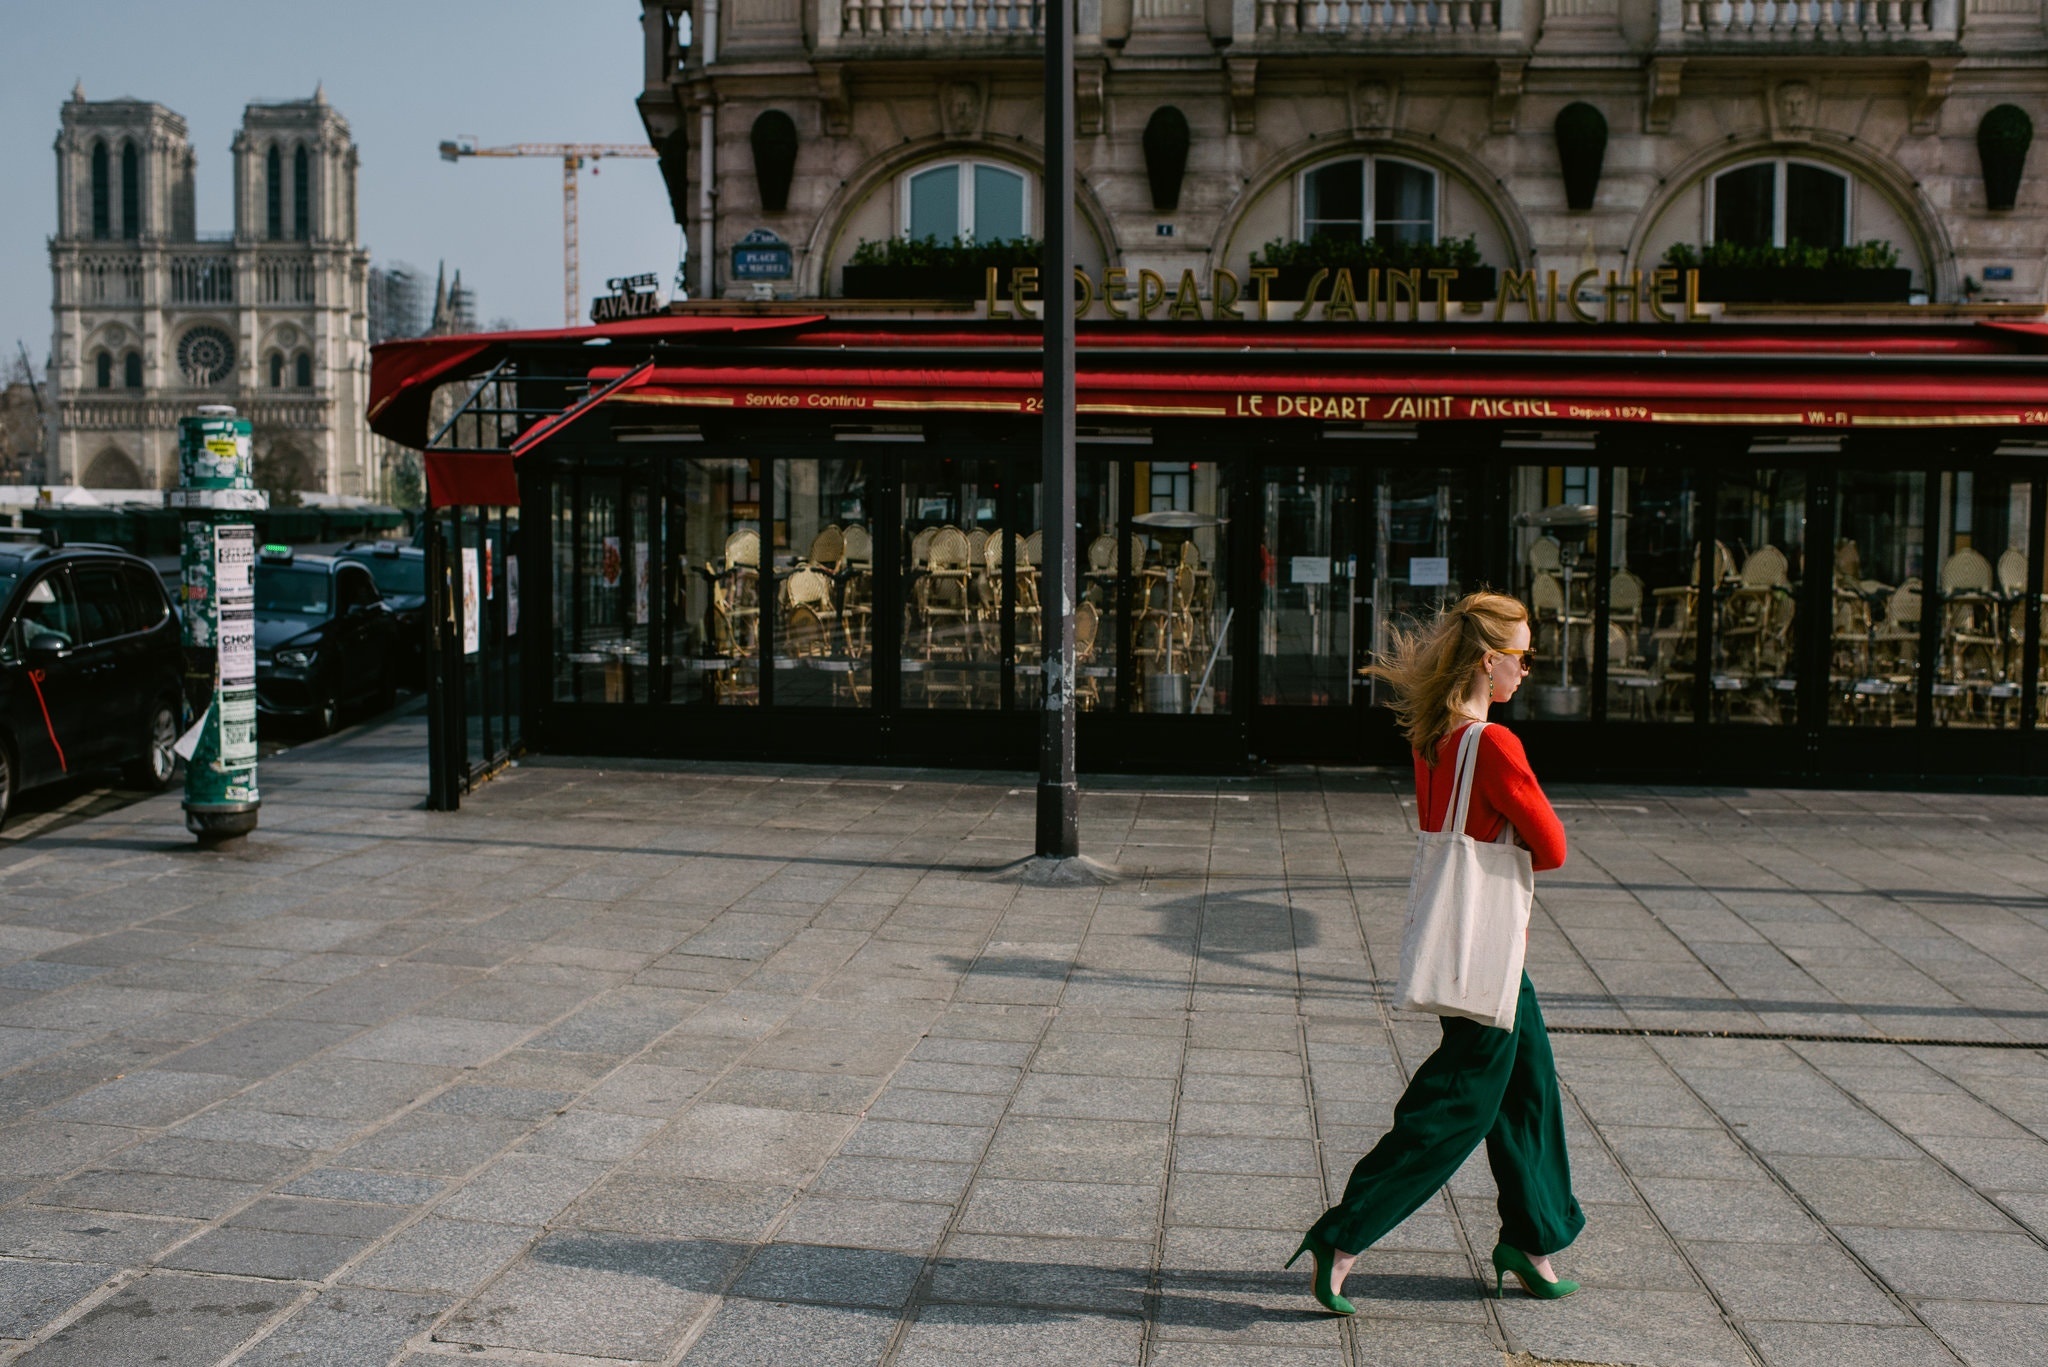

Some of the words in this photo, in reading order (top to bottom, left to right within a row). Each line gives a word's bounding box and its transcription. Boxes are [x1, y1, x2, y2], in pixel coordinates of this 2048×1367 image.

[746, 253, 778, 263] PLACE
[749, 264, 786, 273] MICHEL
[591, 290, 660, 320] LAVAZZA
[986, 267, 1039, 320] LE
[1495, 268, 1711, 324] MICHEL
[745, 393, 800, 407] Service
[807, 394, 866, 408] Continu
[1237, 395, 1263, 416] LE
[1277, 395, 1370, 418] DEPART
[1383, 396, 1454, 419] SAINT
[1469, 398, 1558, 418] MICHEL
[1569, 405, 1611, 420] Depuis
[1615, 406, 1648, 419] 1879
